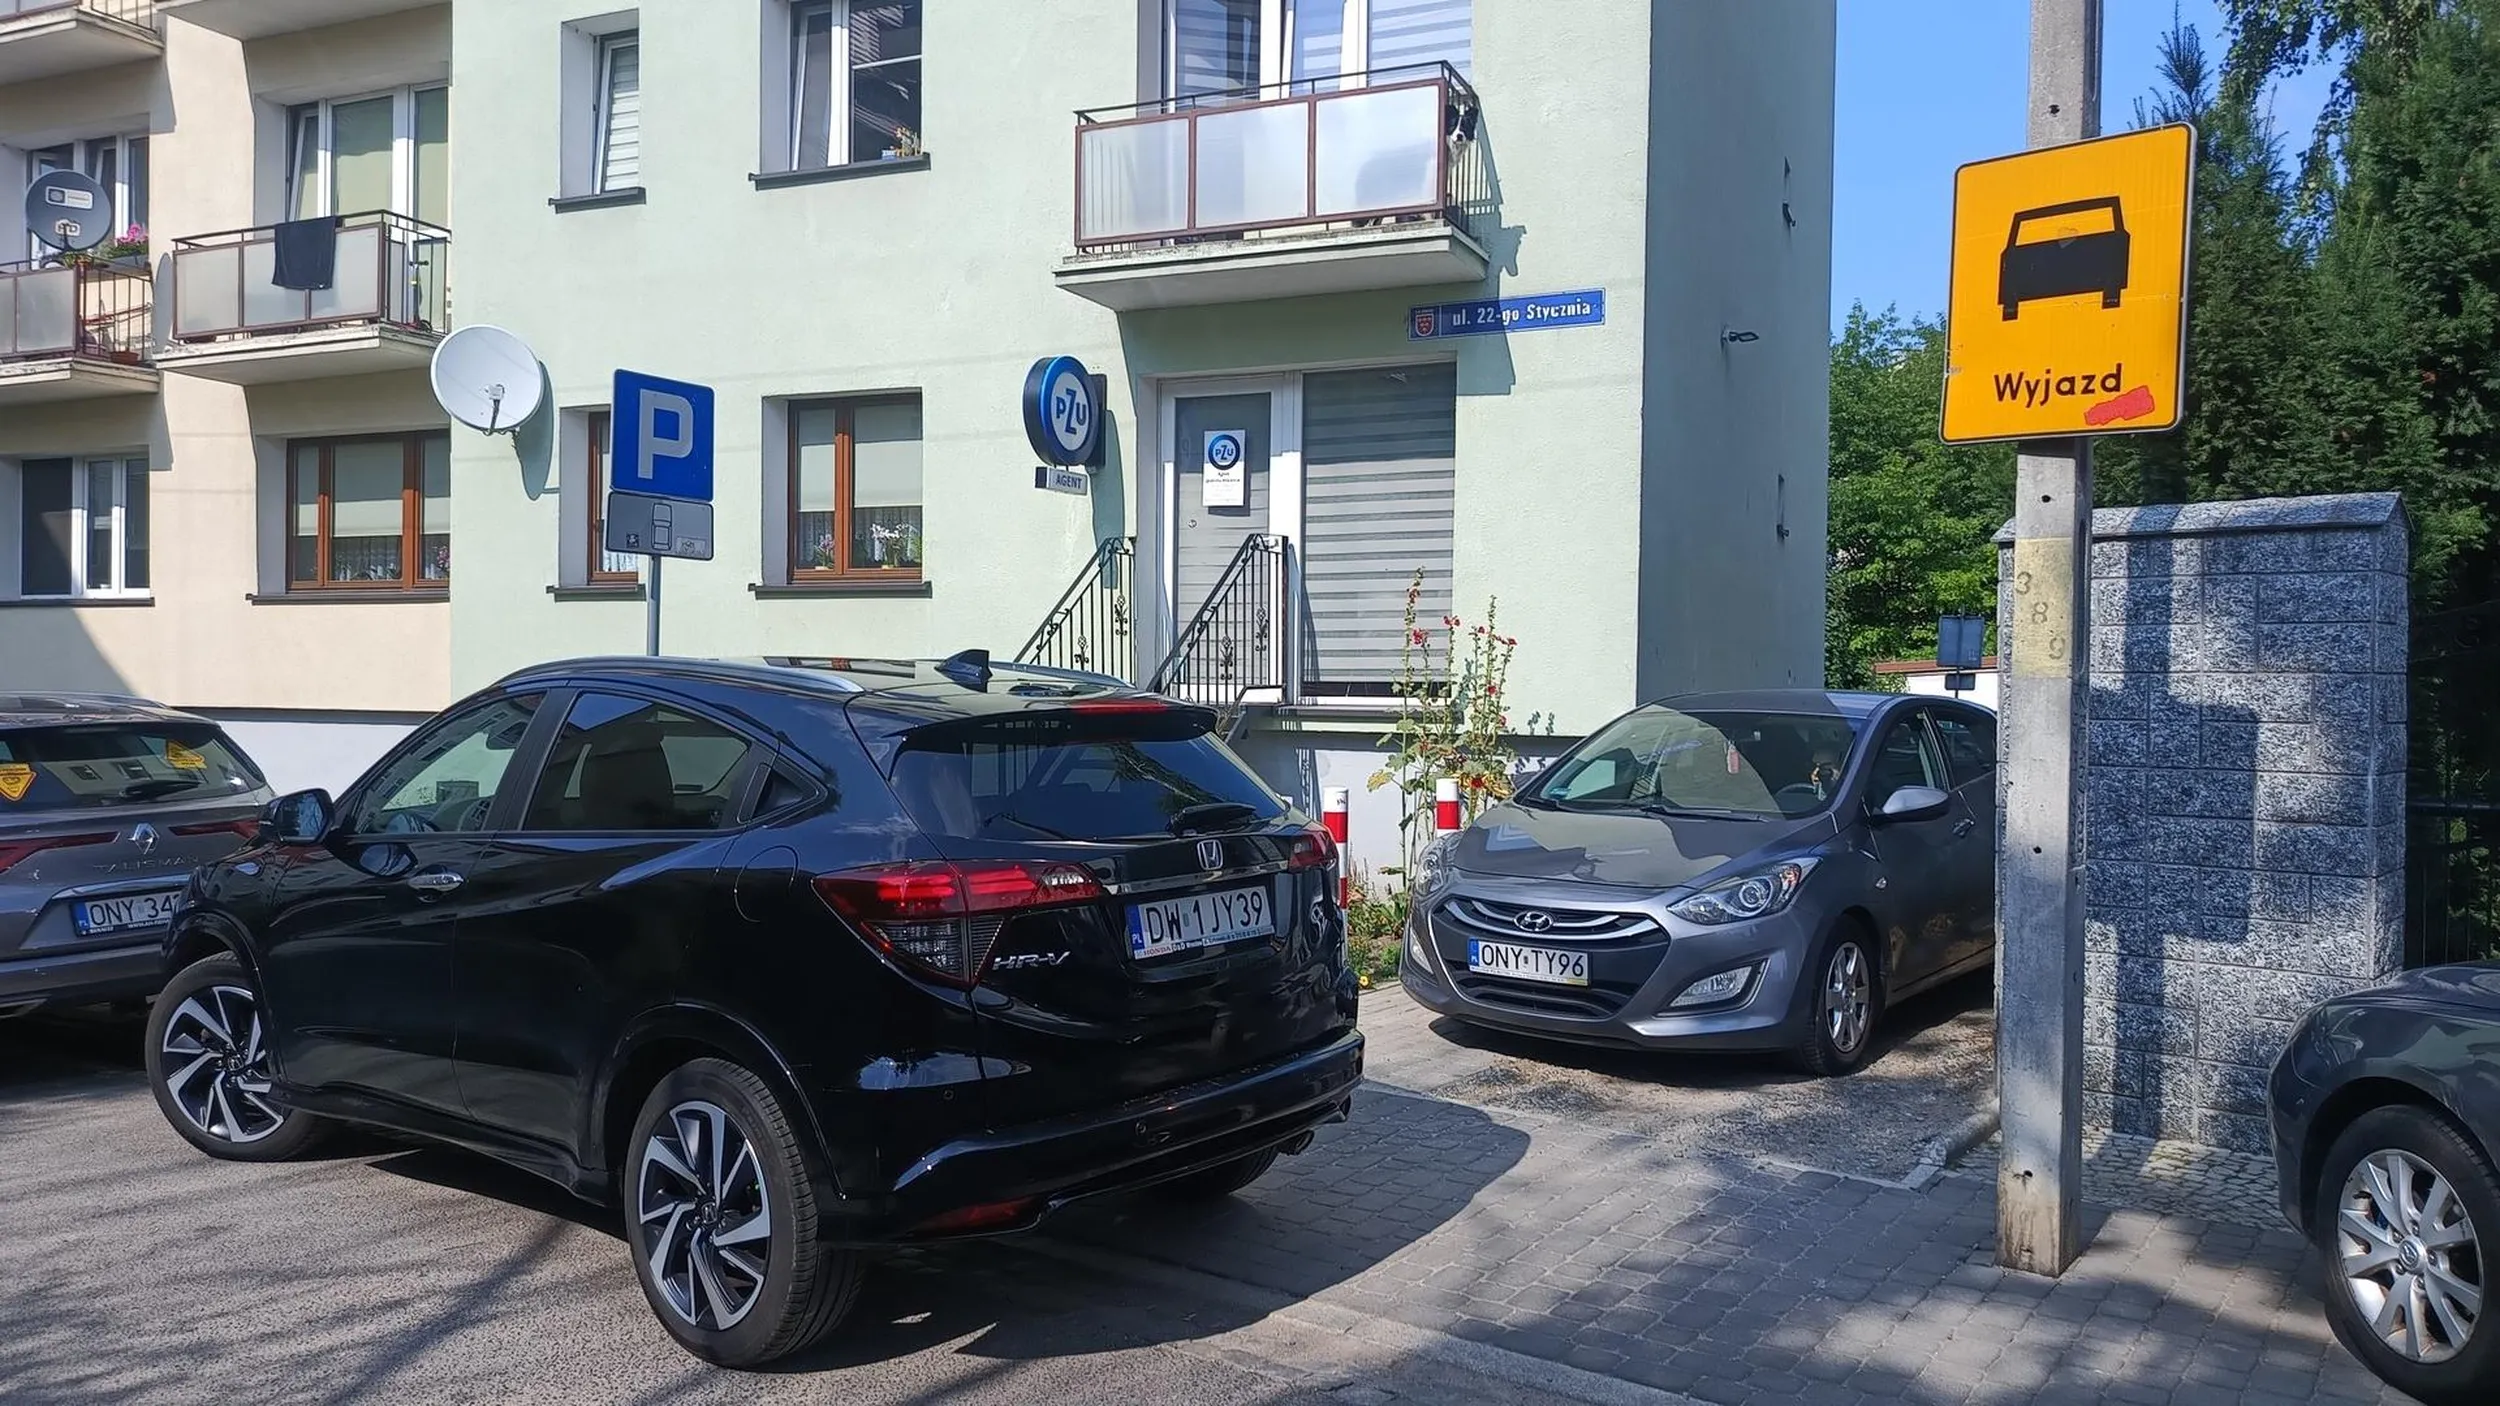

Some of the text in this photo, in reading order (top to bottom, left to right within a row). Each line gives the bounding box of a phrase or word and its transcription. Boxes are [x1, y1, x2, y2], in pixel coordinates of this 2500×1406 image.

[1452, 298, 1591, 326] ul. 22-go Stycznia
[1993, 362, 2123, 409] Wyjazd
[1055, 387, 1087, 435] PZU
[637, 387, 694, 480] P
[1215, 444, 1234, 461] PZU
[1055, 473, 1083, 489] AGENT
[89, 899, 135, 926] ONY
[143, 893, 180, 919] 34
[1145, 903, 1183, 944] DW
[1192, 890, 1263, 936] 1JY39
[1131, 932, 1143, 945] PL
[992, 950, 1071, 971] HR-V
[1481, 944, 1523, 970] ONY
[1531, 949, 1585, 977] TY96
